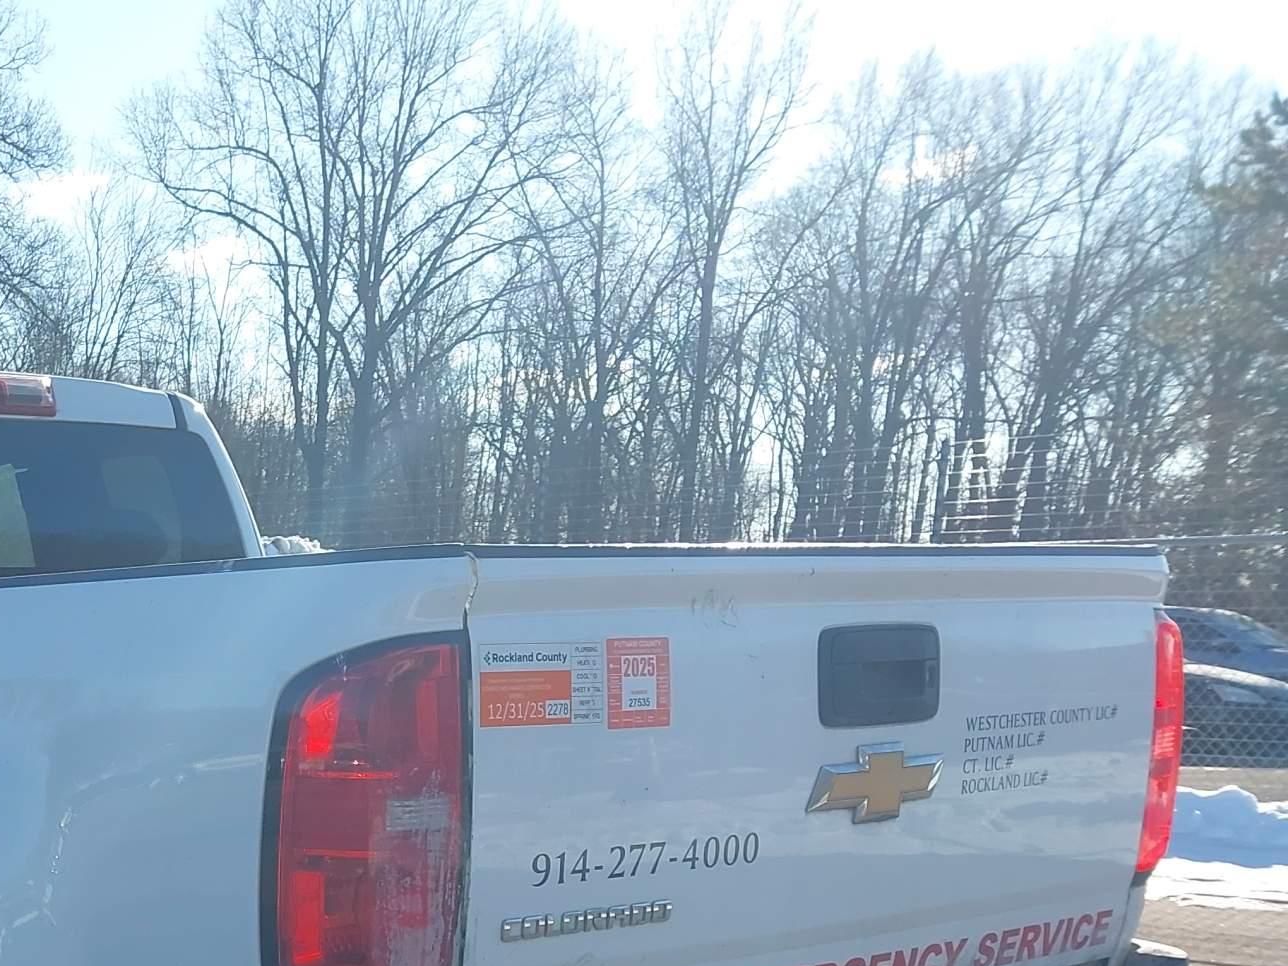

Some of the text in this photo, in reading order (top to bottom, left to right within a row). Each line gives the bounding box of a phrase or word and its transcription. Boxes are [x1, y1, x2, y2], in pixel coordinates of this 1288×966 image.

[492, 651, 568, 665] Rockland County
[623, 657, 656, 678] 2025
[488, 701, 545, 721] 12/31/25
[547, 702, 569, 716] 2278
[628, 697, 651, 708] 27535
[966, 711, 1046, 732] WESTCHESTER
[1050, 707, 1093, 725] COUNTY
[964, 735, 1014, 753] PUTNAM
[963, 758, 981, 774] CT.
[961, 774, 1020, 795] ROCKLAND
[531, 831, 760, 888] 914-277-4000
[500, 900, 673, 943] COLORADO
